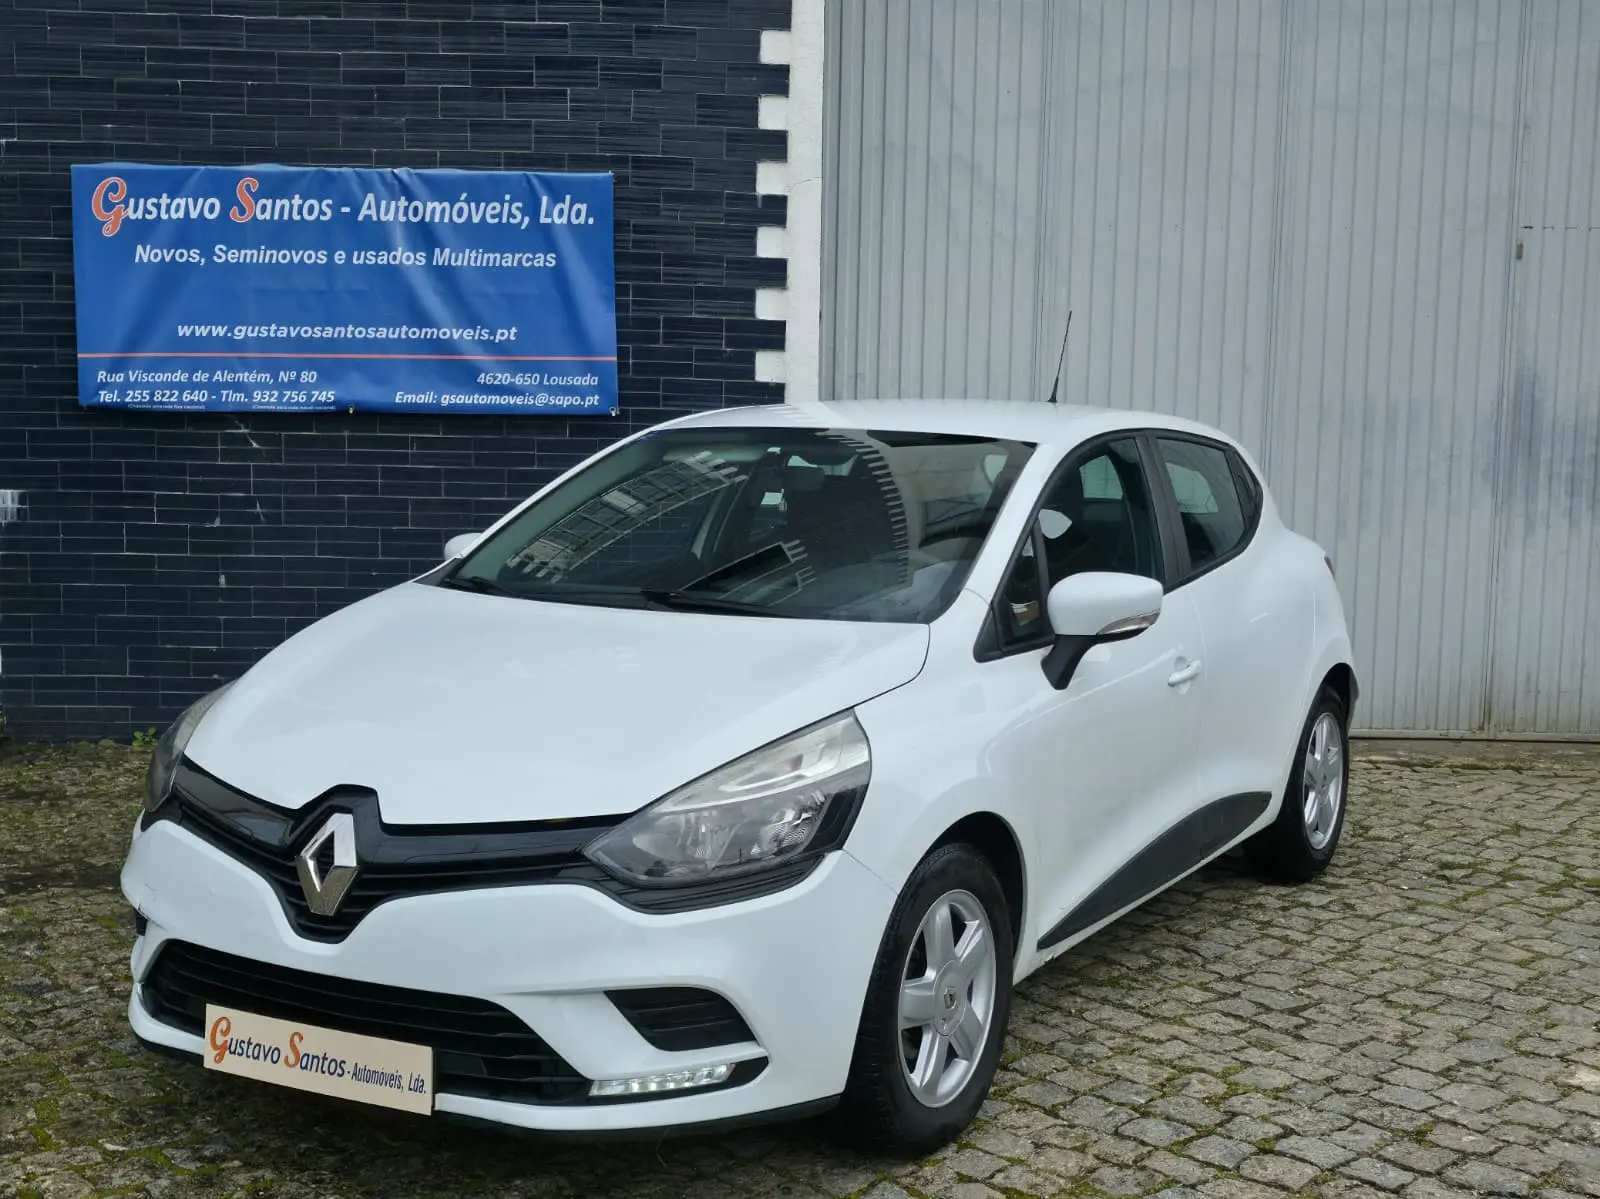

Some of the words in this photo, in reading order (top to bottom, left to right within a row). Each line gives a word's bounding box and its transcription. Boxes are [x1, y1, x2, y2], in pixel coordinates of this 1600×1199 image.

[92, 176, 221, 237] Gustavo
[229, 177, 332, 222] Santos
[357, 192, 530, 229] Automóveis,
[539, 194, 595, 225] Lda.
[135, 244, 205, 266] Novos,
[213, 244, 328, 265] Seminovos
[334, 251, 346, 265] e
[352, 247, 427, 266] usados
[432, 247, 557, 268] Multimarcas
[177, 323, 518, 344] www.gustavosantosautomoveis.pt
[97, 370, 124, 383] Rua
[128, 370, 189, 383] Visconde
[192, 370, 209, 383] de
[299, 371, 317, 384] 80
[476, 373, 541, 386] 4620-650
[543, 373, 600, 387] Lousada
[98, 390, 121, 403] Tel.
[125, 390, 150, 403] 255
[153, 390, 179, 403] 822
[182, 390, 208, 403] 640
[220, 390, 249, 403] Tlm.
[252, 390, 278, 403] 932
[282, 390, 307, 403] 756
[310, 390, 336, 403] 745
[395, 391, 438, 405] Email:
[209, 1016, 281, 1065] Gustavo
[284, 1031, 346, 1078] Santos
[351, 1062, 404, 1093] Automóveis,
[408, 1071, 427, 1095] Lda.
